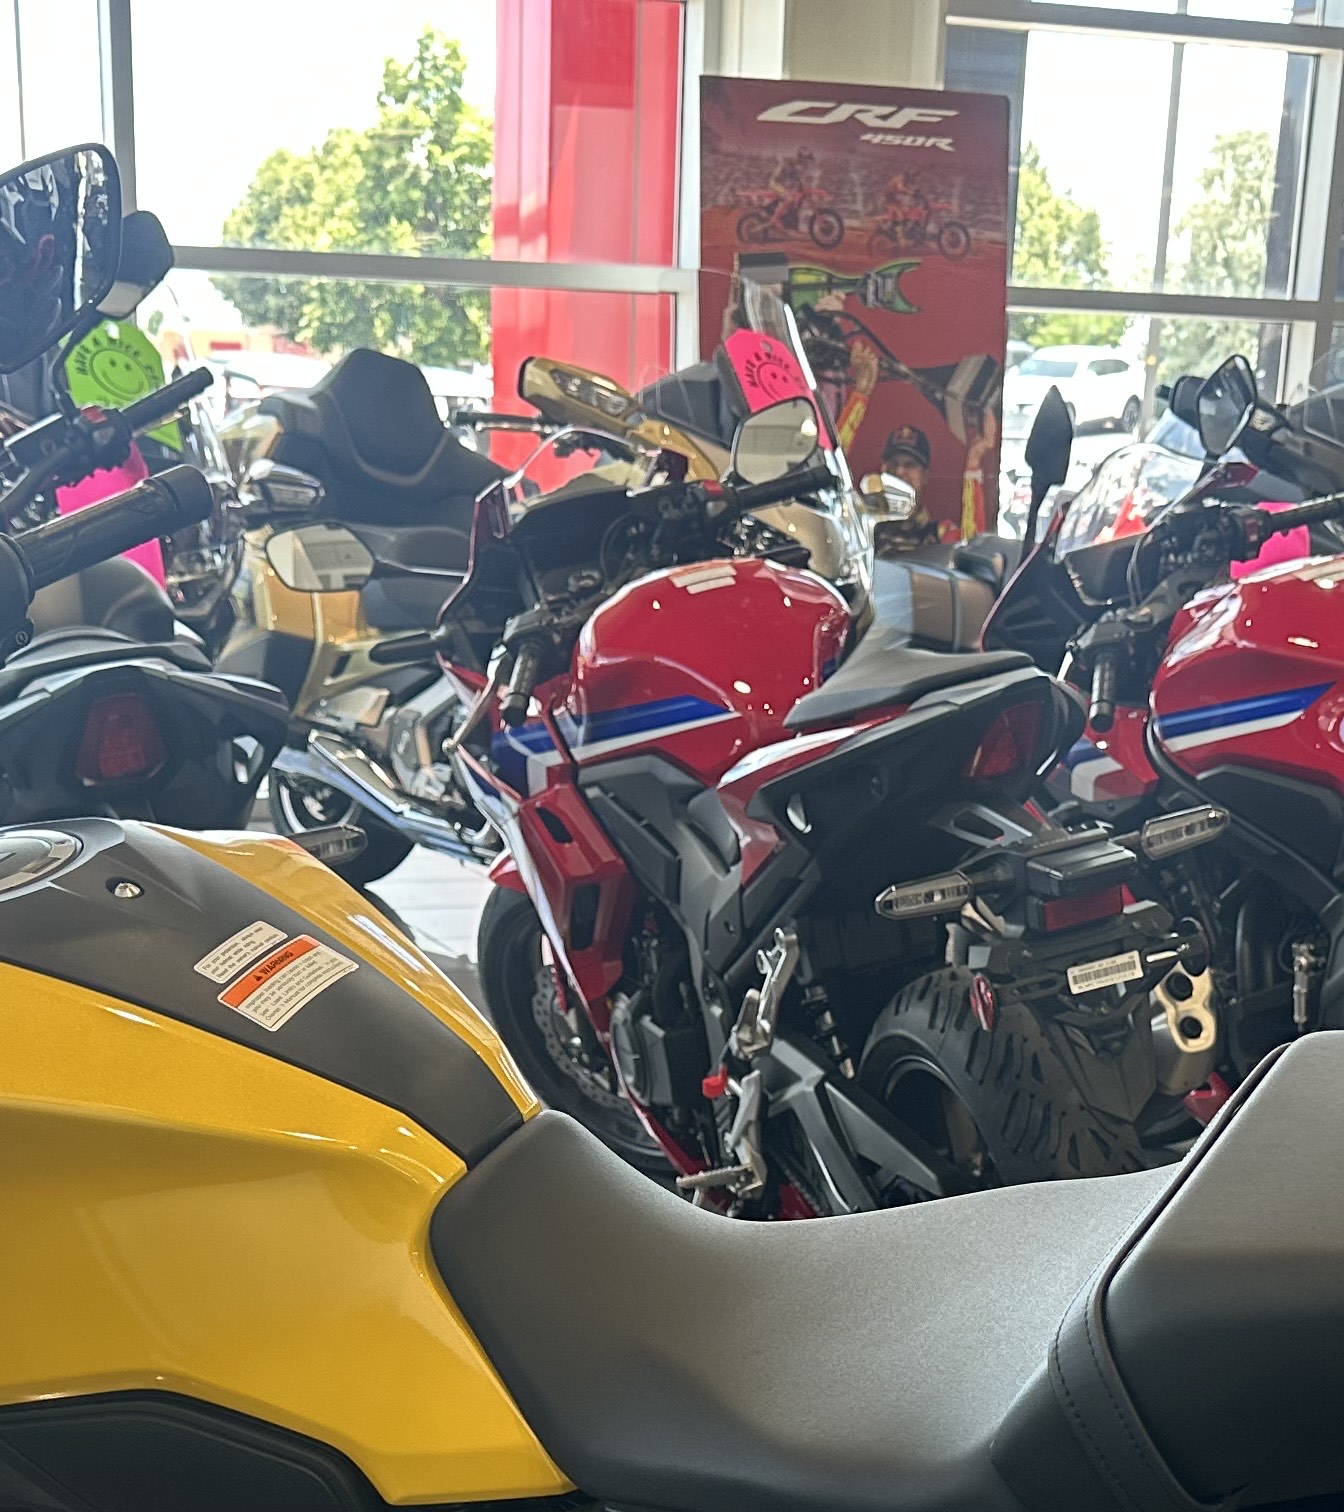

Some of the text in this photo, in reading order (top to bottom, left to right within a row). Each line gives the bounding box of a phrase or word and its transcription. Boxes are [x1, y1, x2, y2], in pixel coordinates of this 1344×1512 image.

[757, 100, 959, 128] CRF
[860, 133, 955, 151] 450R
[259, 950, 294, 975] WARNING
